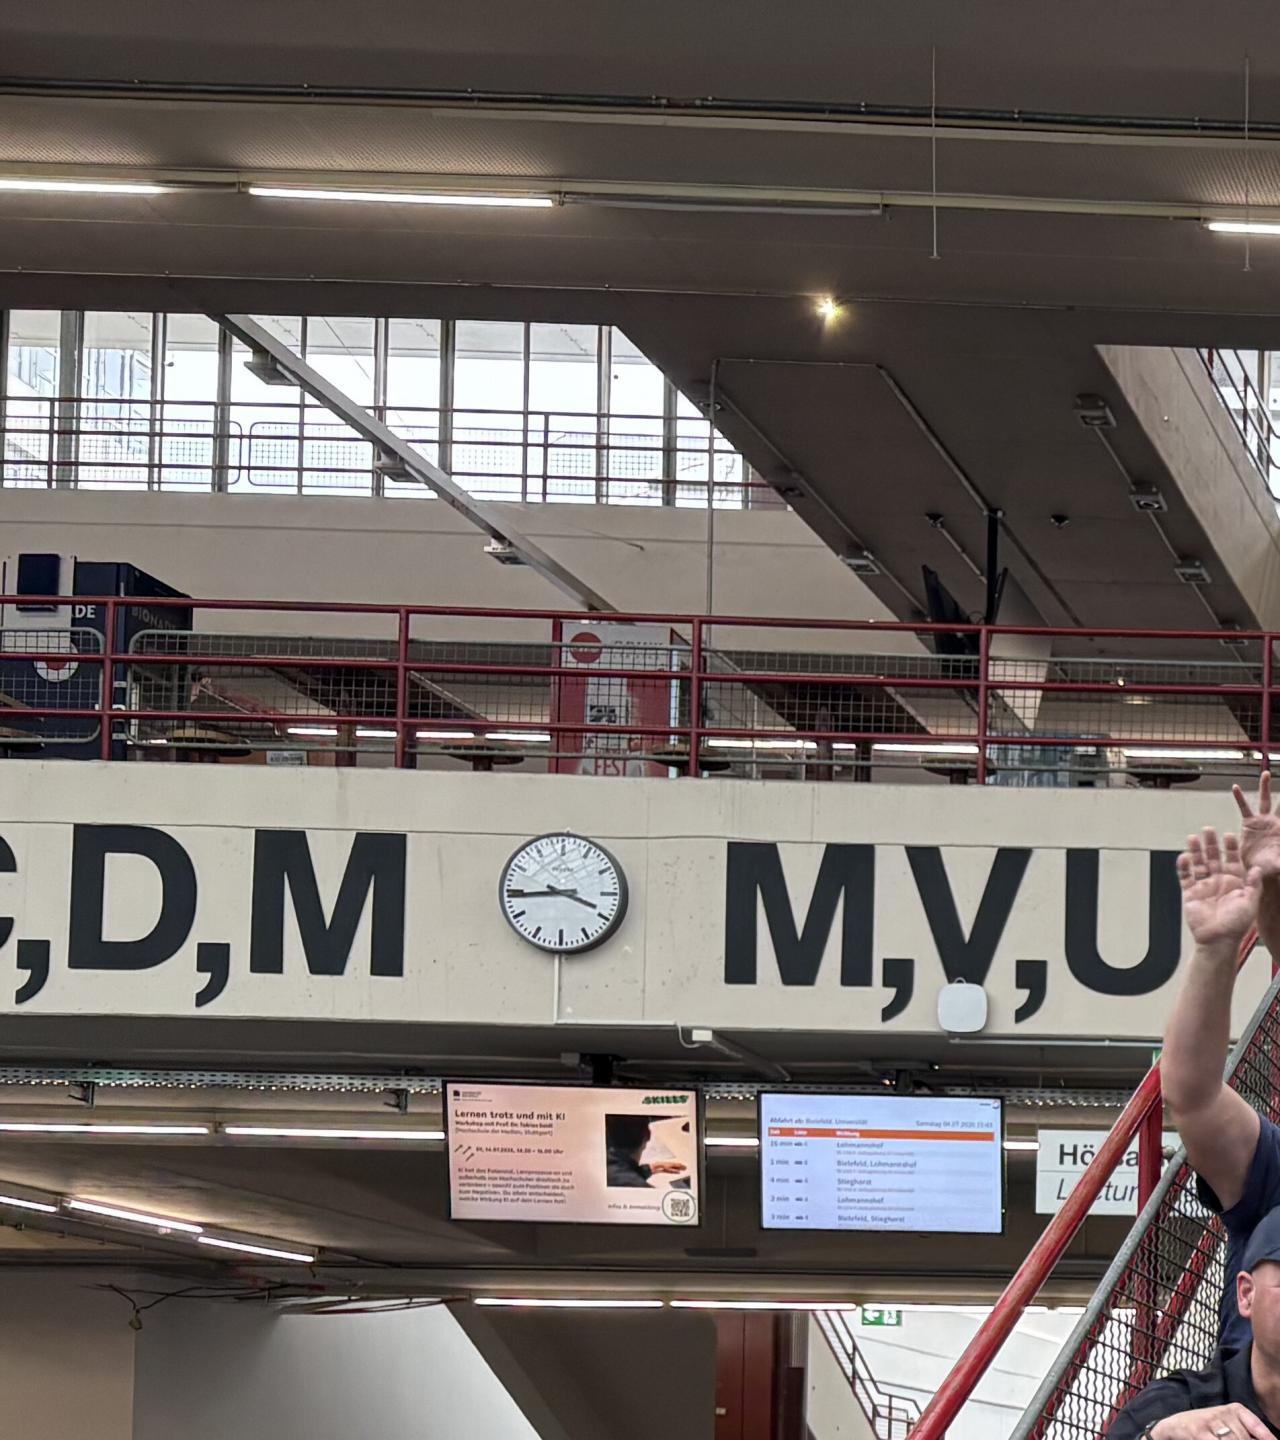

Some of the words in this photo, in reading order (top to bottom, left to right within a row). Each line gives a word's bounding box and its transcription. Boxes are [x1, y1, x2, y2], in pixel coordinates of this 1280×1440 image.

[0, 823, 407, 1007] ,D,M
[455, 1110, 487, 1119] Lernen
[490, 1111, 514, 1119] trotz
[516, 1112, 534, 1120] und
